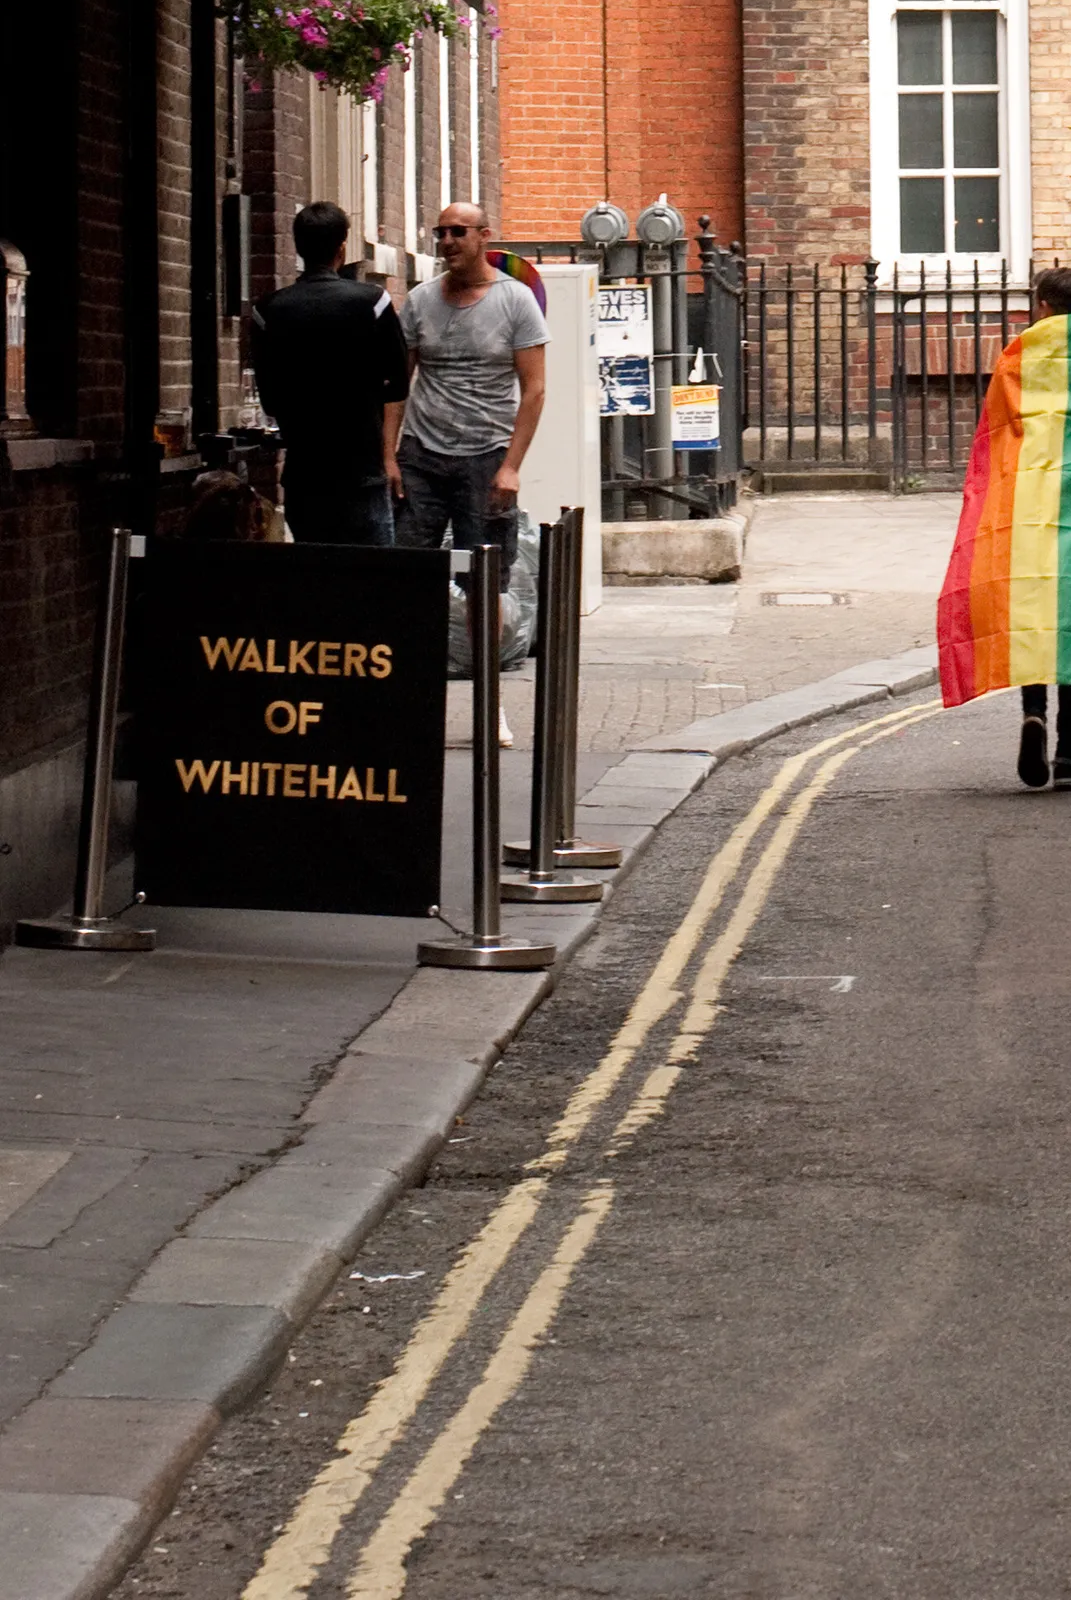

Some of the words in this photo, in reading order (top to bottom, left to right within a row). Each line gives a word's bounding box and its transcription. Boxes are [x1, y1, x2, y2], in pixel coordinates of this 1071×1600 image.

[200, 636, 393, 679] WALKERS
[264, 700, 323, 735] OF
[175, 759, 407, 803] WHITEHALL
